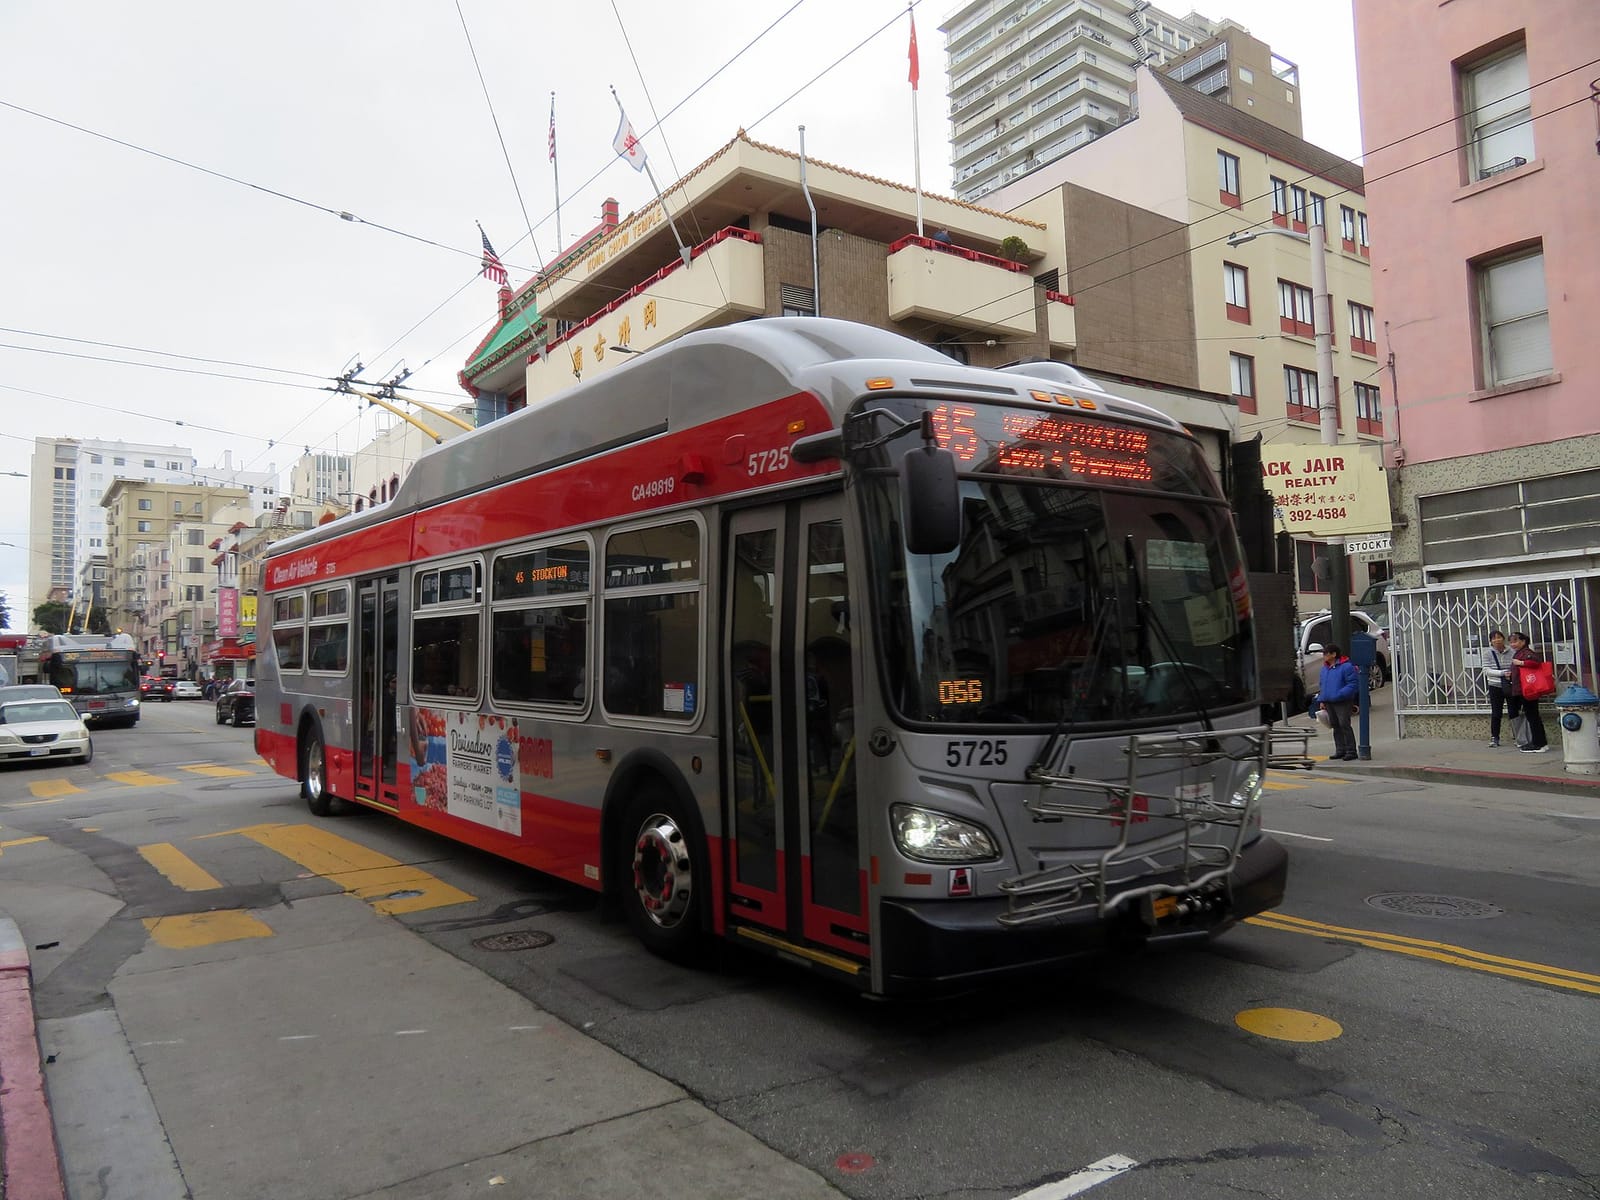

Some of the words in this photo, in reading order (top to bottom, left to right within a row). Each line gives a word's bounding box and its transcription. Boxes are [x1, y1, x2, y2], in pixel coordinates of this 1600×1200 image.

[632, 207, 662, 240] TEMPLE
[747, 445, 790, 477] 5725
[1303, 457, 1345, 474] JAIR
[631, 476, 675, 502] CA49819
[1285, 476, 1337, 489] REALTY
[1289, 507, 1347, 522] 392-4584
[273, 566, 289, 585] Clean
[288, 561, 297, 580] Air
[297, 556, 318, 579] Vehicle
[532, 565, 568, 581] STOCKTON
[451, 729, 492, 757] Divisadero
[946, 740, 1008, 768] 5725
[452, 759, 472, 771] FARMERS
[473, 764, 492, 776] MARKET
